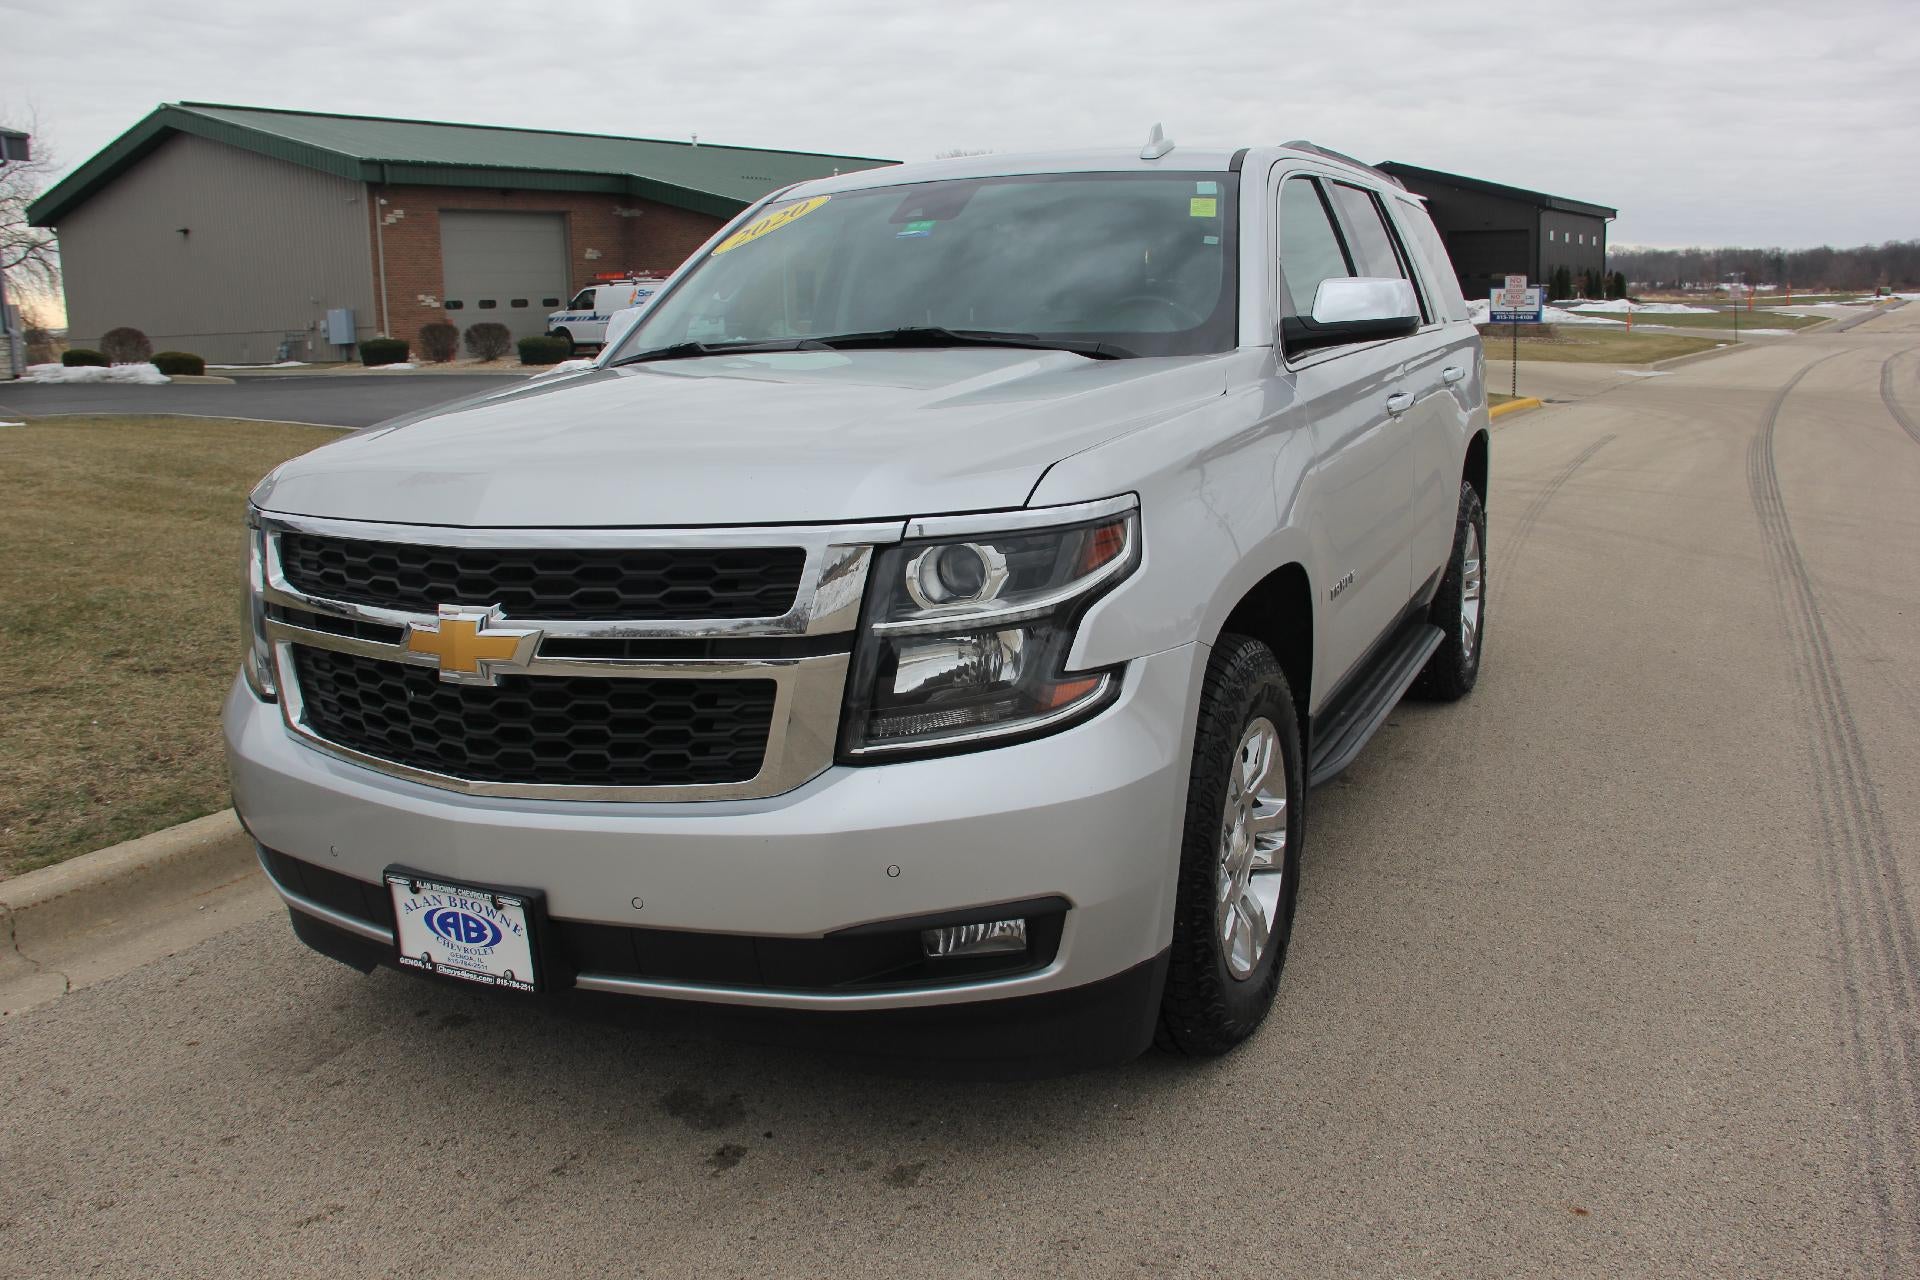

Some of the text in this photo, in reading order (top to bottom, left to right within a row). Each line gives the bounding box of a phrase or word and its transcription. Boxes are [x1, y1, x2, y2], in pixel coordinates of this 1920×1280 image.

[734, 201, 811, 245] 2020
[416, 881, 492, 901] ALAN BROWNE CHEVROLET
[403, 894, 524, 937] ALAN BROWNE
[436, 911, 489, 944] AB
[436, 936, 495, 957] CHEVROLET
[399, 956, 425, 969] GENOA,
[425, 961, 433, 970] IL
